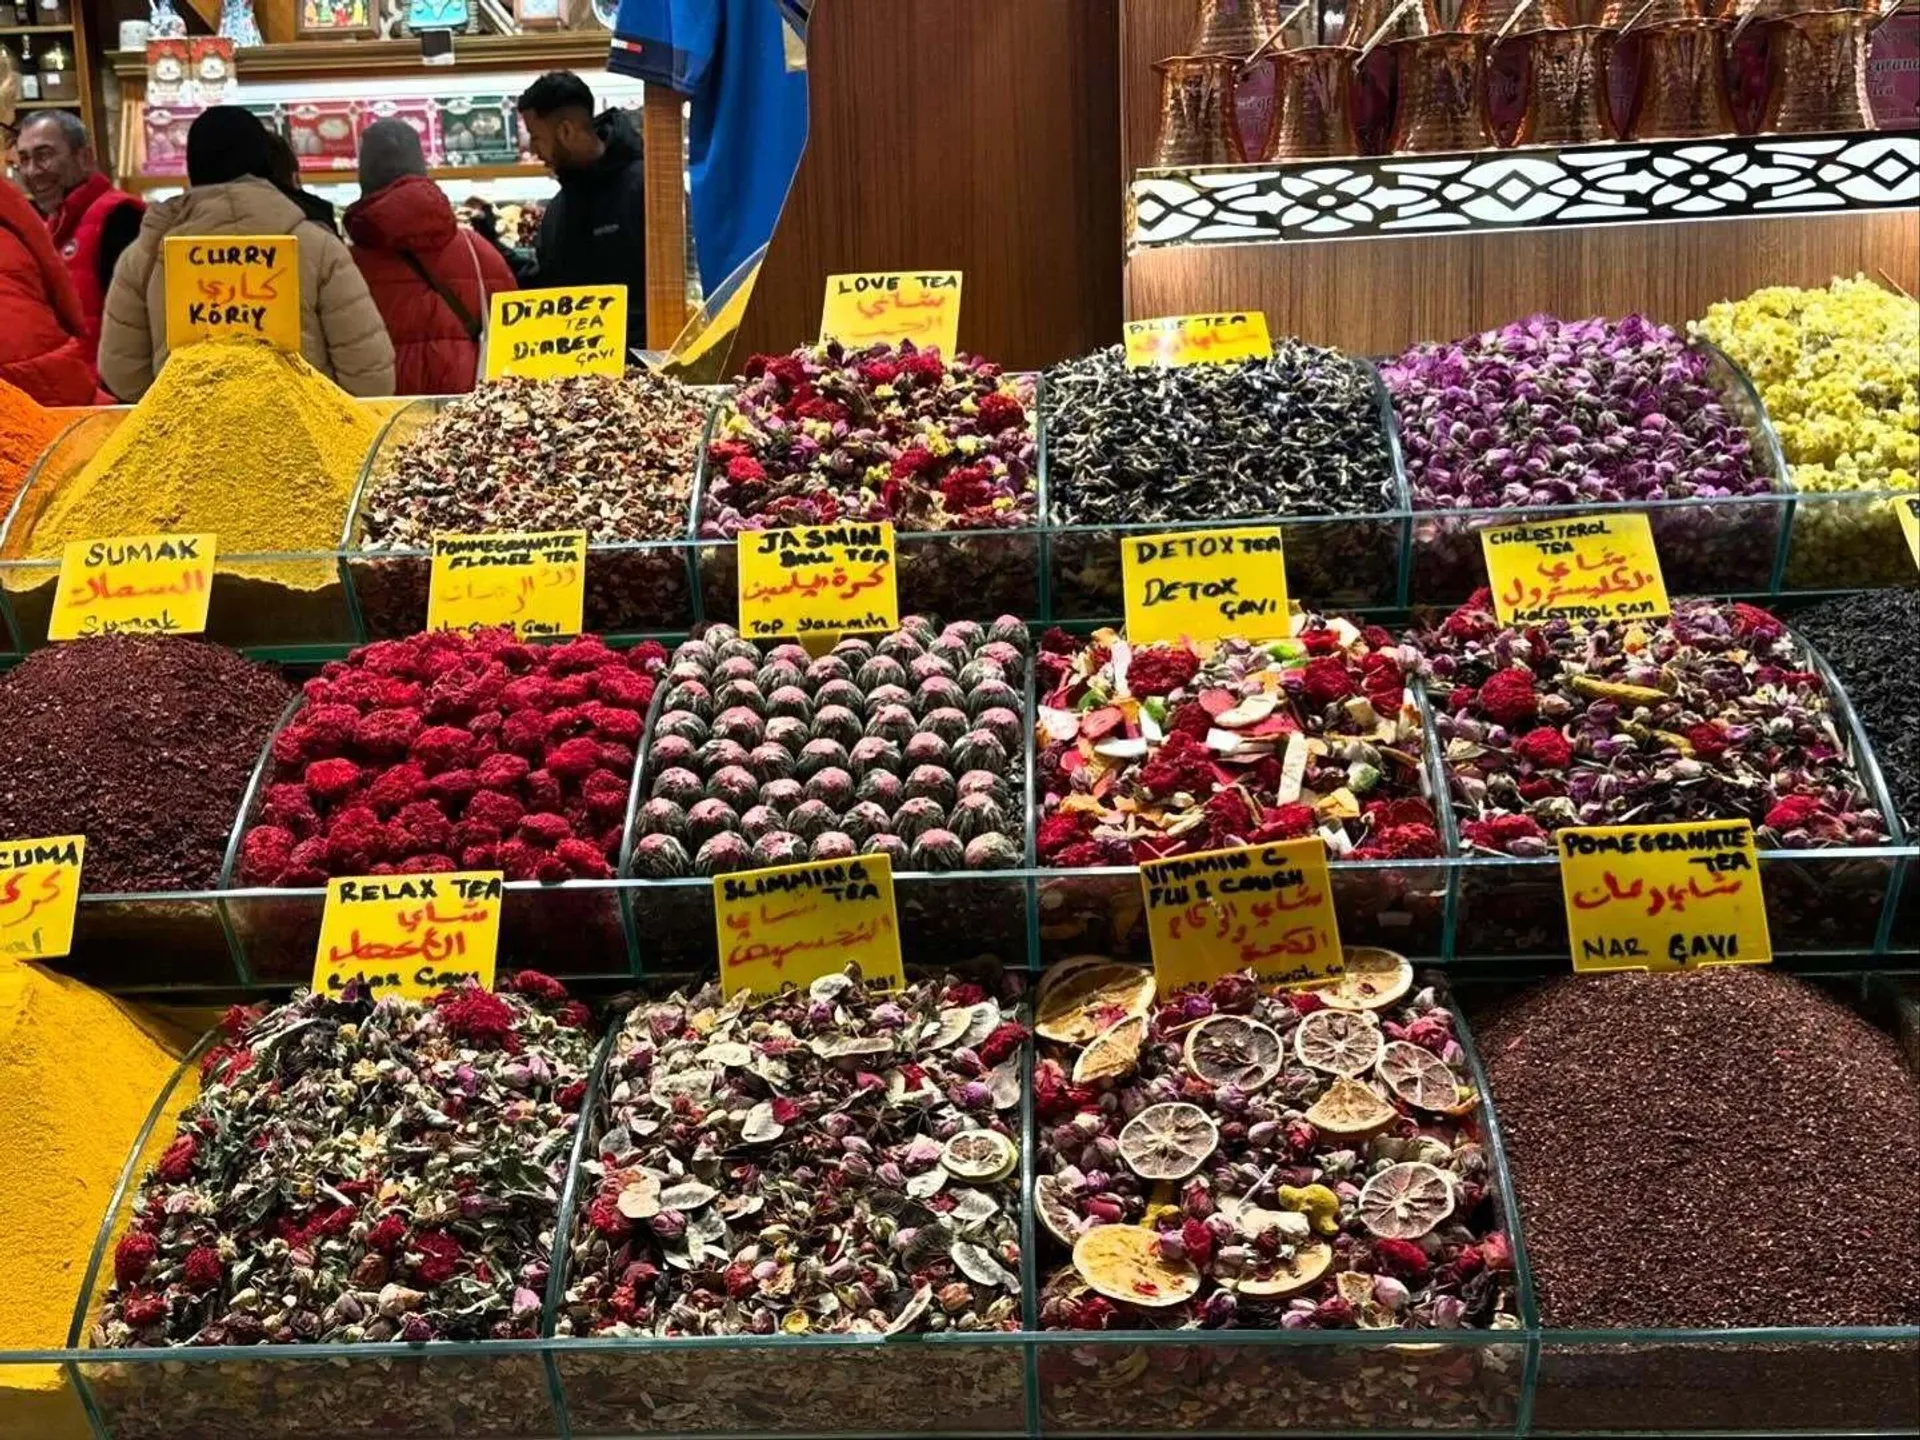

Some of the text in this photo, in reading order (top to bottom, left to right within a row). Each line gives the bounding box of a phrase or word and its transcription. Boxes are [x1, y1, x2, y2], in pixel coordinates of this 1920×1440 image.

[189, 245, 276, 268] CURRY
[838, 275, 957, 294] LOVE TEA
[565, 314, 604, 331] TEA
[1195, 315, 1247, 328] TEA
[758, 525, 881, 553] JASMIN
[1490, 520, 1611, 544] CHOLESTEROL
[85, 538, 199, 567] SUMAK
[543, 551, 578, 563] TEA
[845, 549, 889, 562] TEA
[1136, 536, 1280, 564] DETOX TEA
[1142, 577, 1239, 606] DETOX
[1143, 848, 1288, 885] VITAMIN C
[1688, 852, 1750, 872] TEA
[340, 878, 503, 903] RELAX TEA
[724, 861, 868, 900] SLIMMING
[821, 882, 880, 902] TEA
[1219, 869, 1304, 893] COUGH
[1582, 936, 1648, 960] NAR
